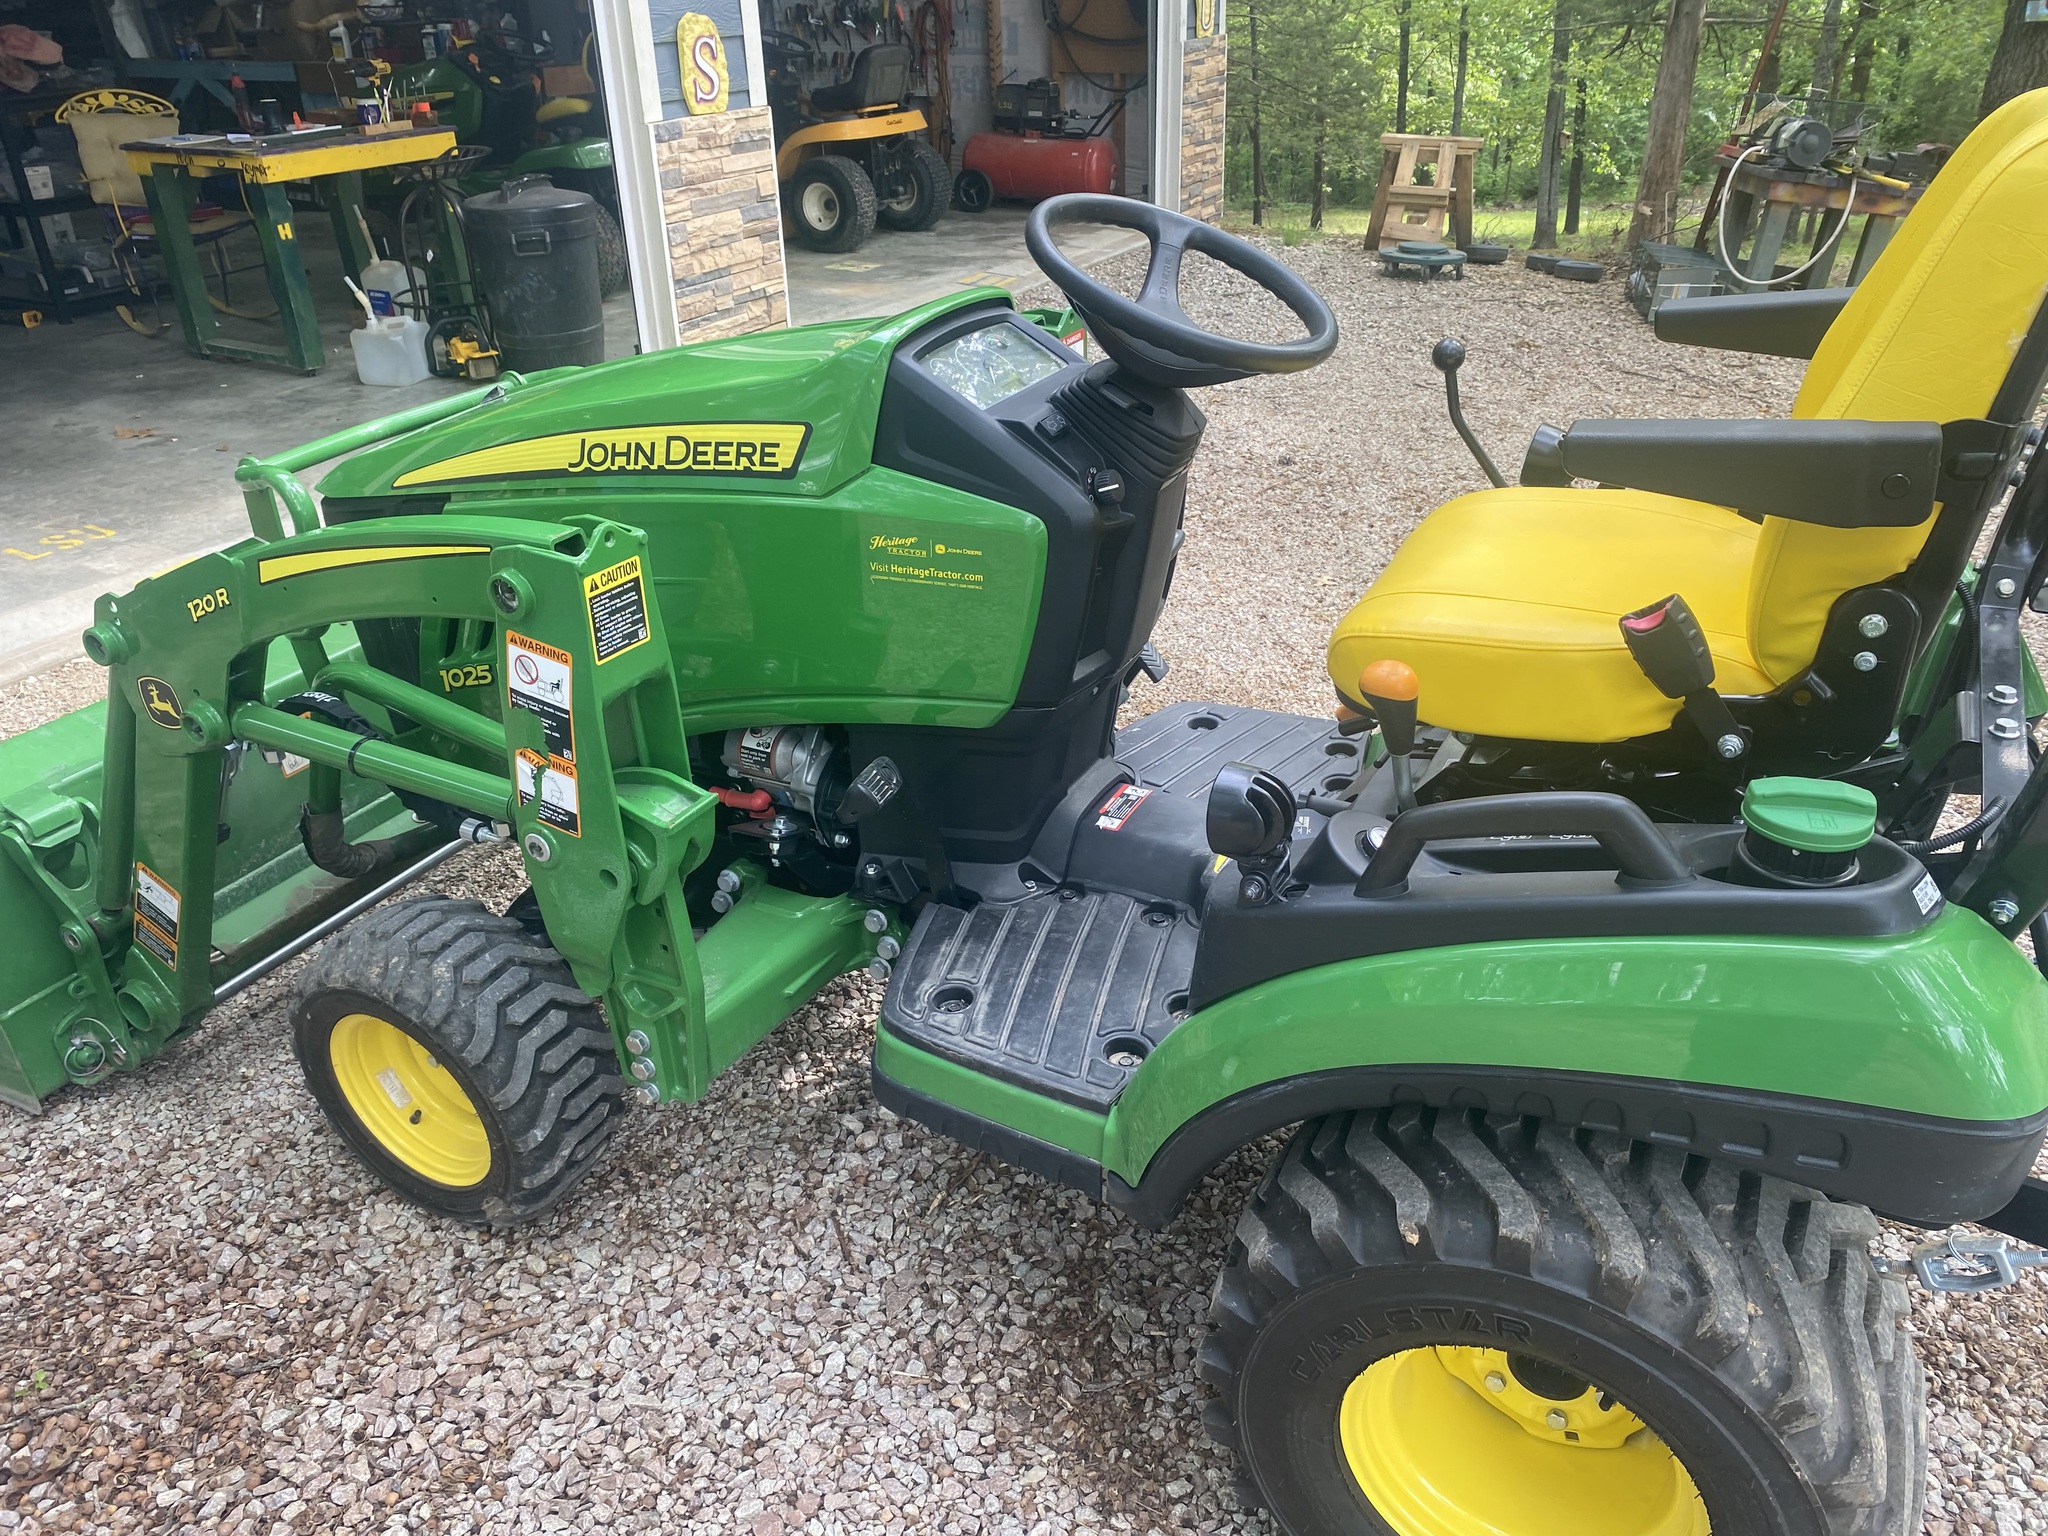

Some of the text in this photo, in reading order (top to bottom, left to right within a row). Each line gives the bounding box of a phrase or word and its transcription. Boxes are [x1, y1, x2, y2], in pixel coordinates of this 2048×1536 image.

[692, 34, 720, 104] S
[568, 435, 782, 471] JOHN DEERE
[4, 524, 117, 561] LSU
[869, 535, 918, 550] Heritage
[887, 547, 927, 558] TRACTOR
[963, 548, 982, 556] DEERE
[600, 559, 638, 587] CAUTION
[869, 561, 984, 582] Visit HeritageTractor.com
[187, 587, 230, 622] 120 R
[518, 636, 568, 663] WARNING
[439, 664, 492, 692] 1025
[1289, 1306, 1532, 1384] CARLSTAR
